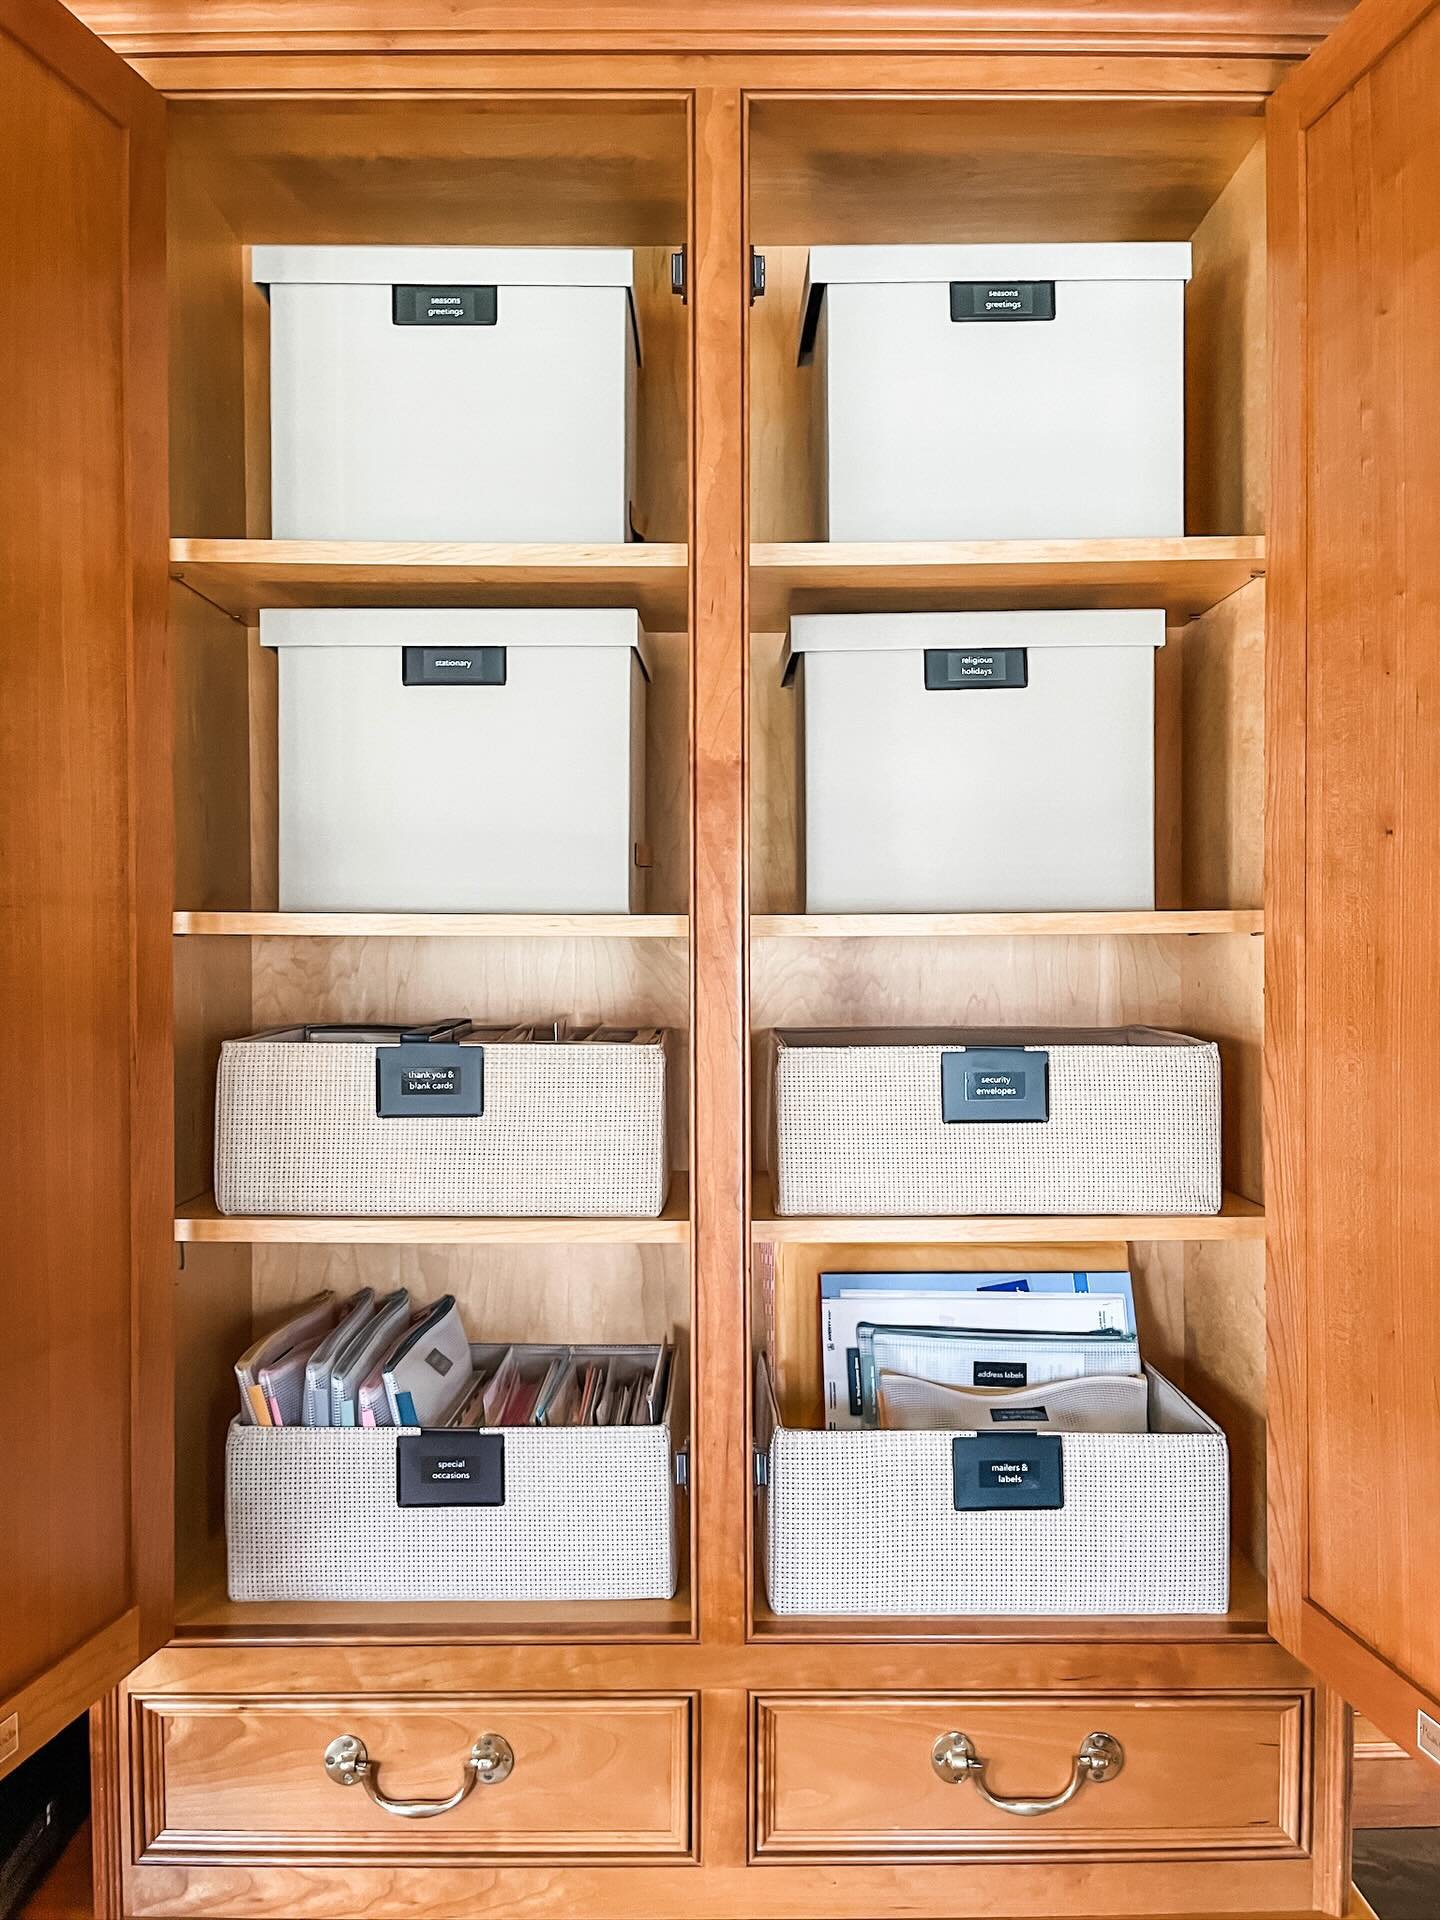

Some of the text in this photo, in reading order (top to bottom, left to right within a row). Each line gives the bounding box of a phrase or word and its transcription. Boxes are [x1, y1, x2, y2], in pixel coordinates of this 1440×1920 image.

[430, 297, 461, 305] seasons
[985, 300, 1022, 310] greetings
[427, 307, 464, 317] greetings
[435, 658, 472, 669] stationary
[961, 655, 993, 666] religious
[961, 667, 993, 677] holidays
[408, 1070, 455, 1081] thank you &
[981, 1075, 1011, 1086] security
[409, 1081, 454, 1090] blank cards
[975, 1086, 1017, 1097] envelopes
[977, 1370, 1024, 1379] address labels
[438, 1459, 465, 1470] special
[991, 1463, 1029, 1472] mailers &
[431, 1471, 471, 1479] occasions
[998, 1474, 1023, 1483] labels
